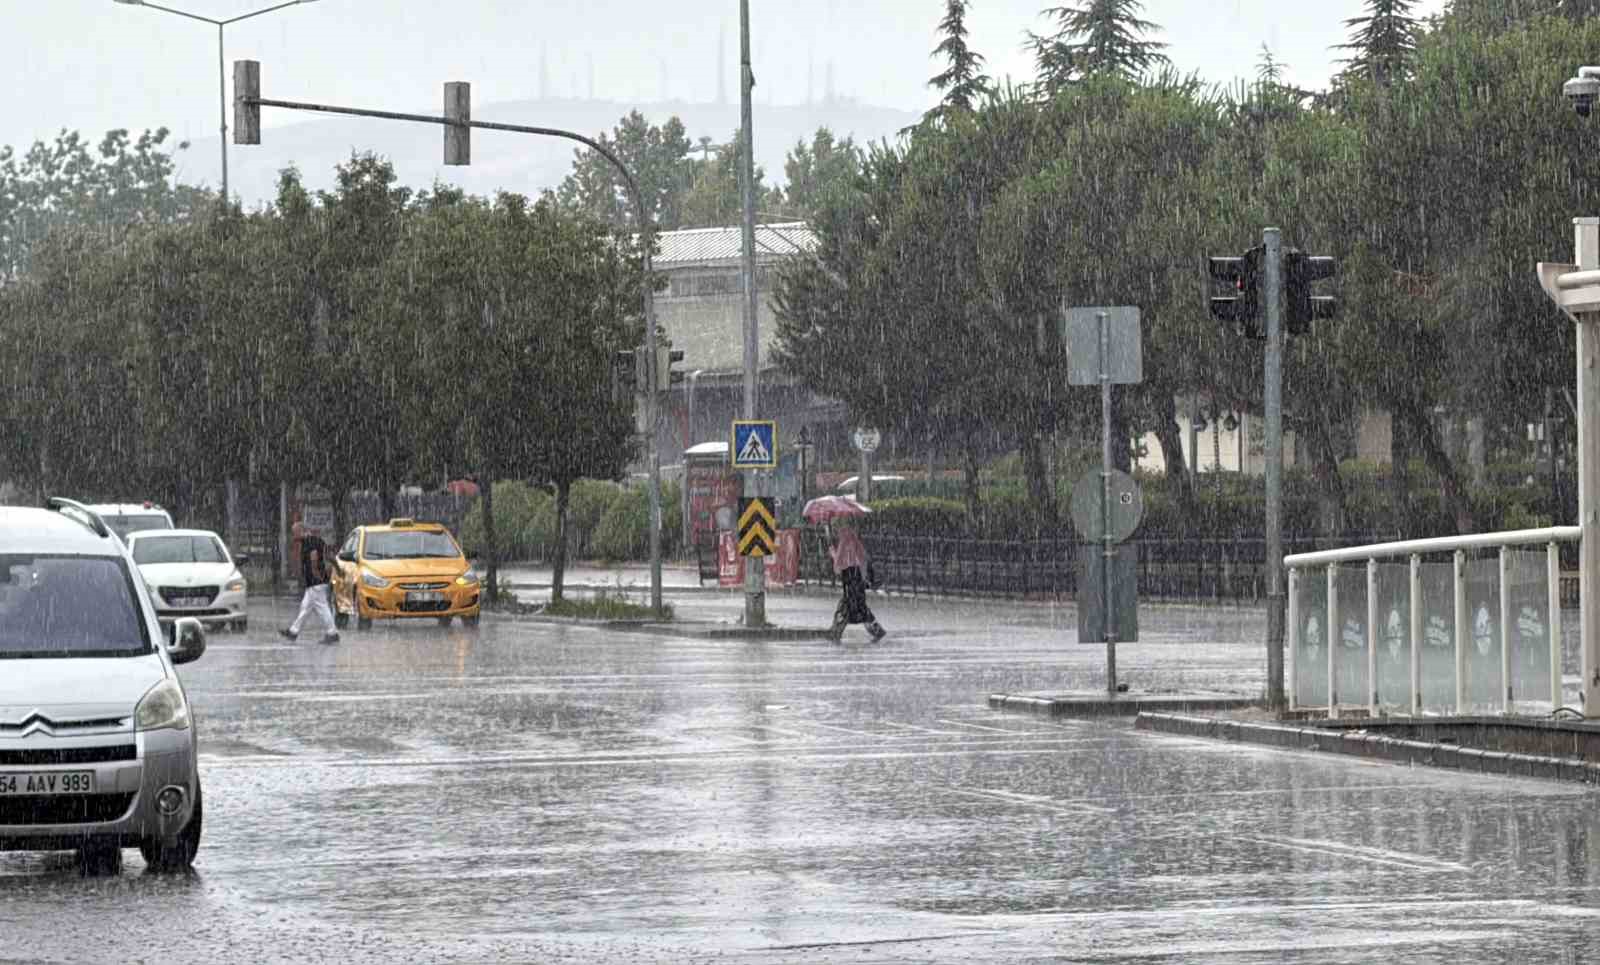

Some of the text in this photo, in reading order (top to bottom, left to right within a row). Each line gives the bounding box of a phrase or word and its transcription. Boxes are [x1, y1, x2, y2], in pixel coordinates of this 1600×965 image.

[0, 774, 90, 793] 54 AAV 989
